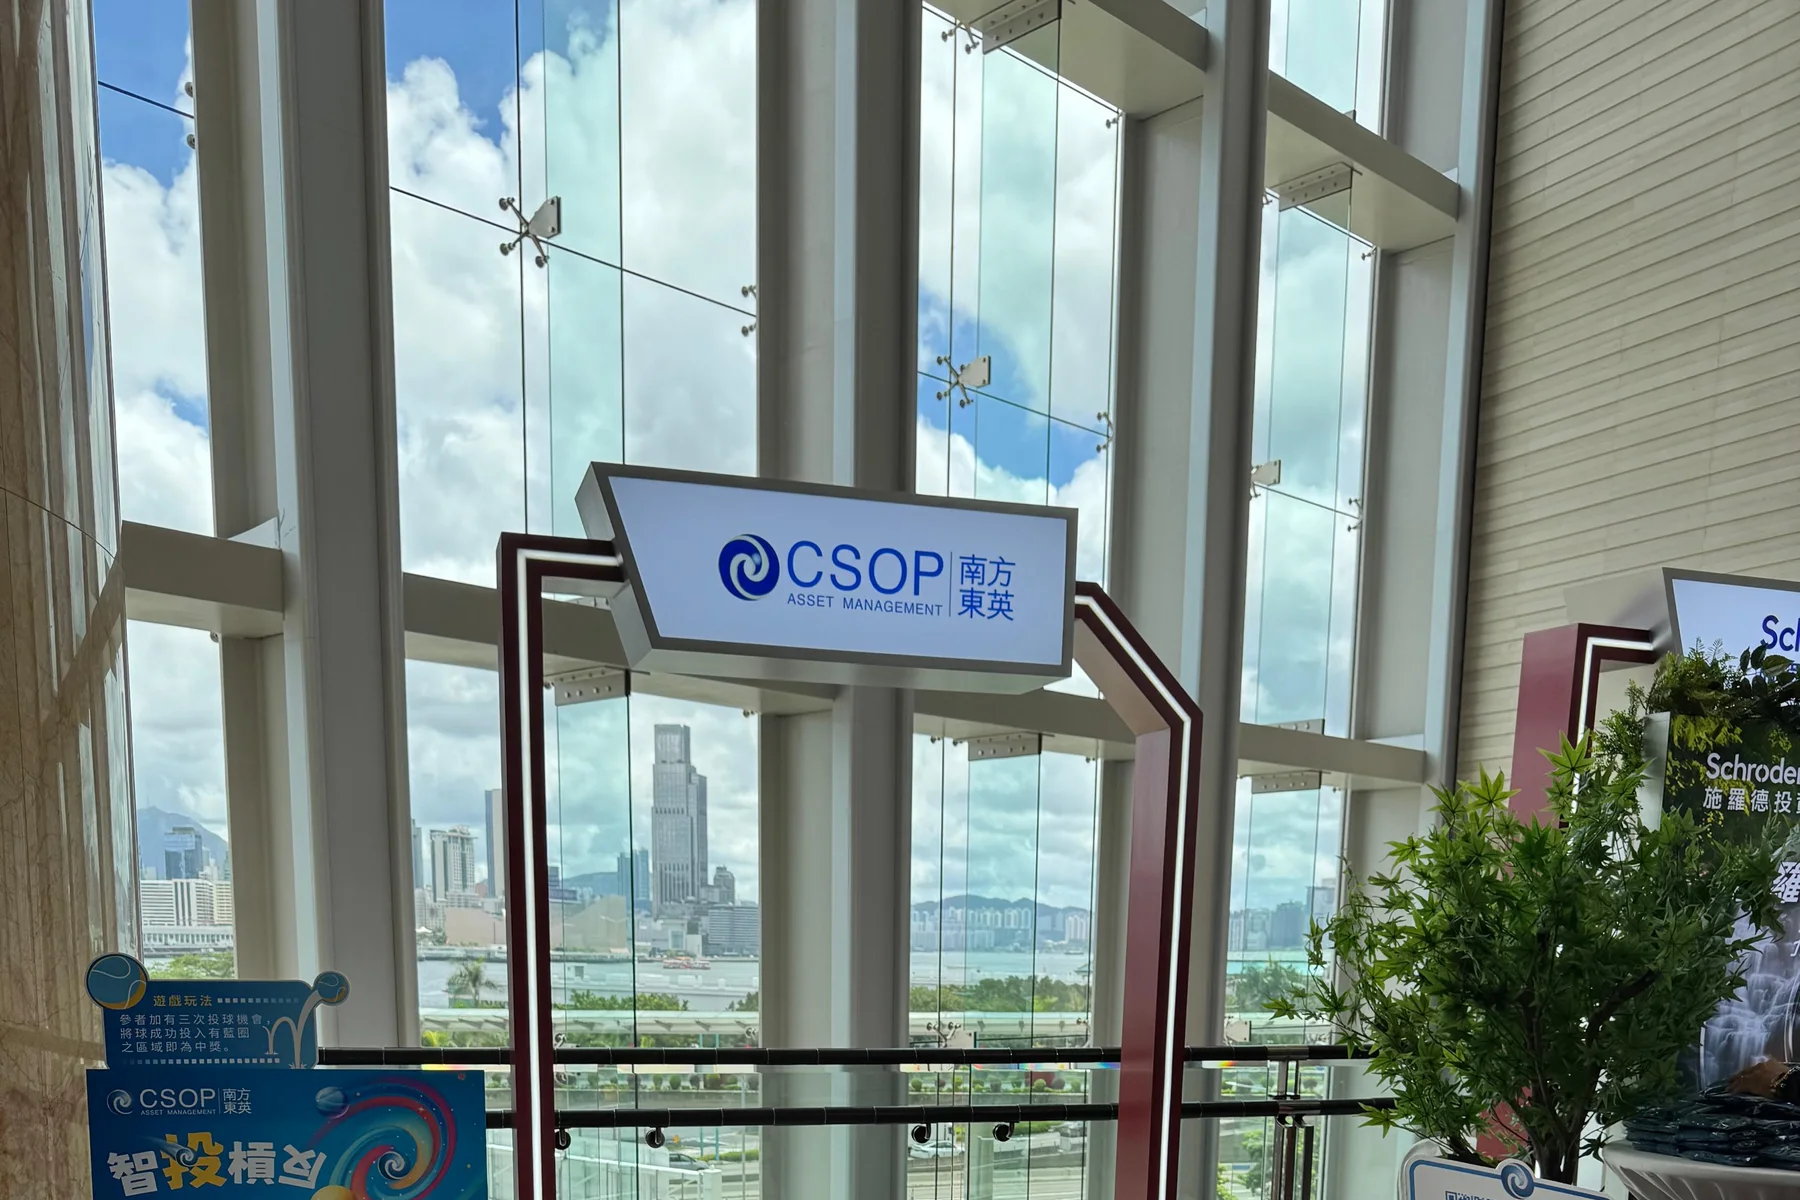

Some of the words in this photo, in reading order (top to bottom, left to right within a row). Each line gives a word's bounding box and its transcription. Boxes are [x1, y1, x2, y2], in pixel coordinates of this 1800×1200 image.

[787, 540, 944, 596] CSOP
[959, 554, 1016, 587] 南方
[787, 593, 834, 608] ASSET
[843, 597, 943, 617] MANAGEMENT
[958, 587, 1015, 621] 東英
[1760, 614, 1800, 652] Sc
[1703, 785, 1800, 814] 施羅德投
[153, 995, 213, 1007] 遊戲玩法
[140, 1088, 216, 1108] CSOP
[222, 1088, 252, 1101] 南方
[167, 1108, 216, 1116] MANAGEMENT
[223, 1101, 252, 1114] 東英
